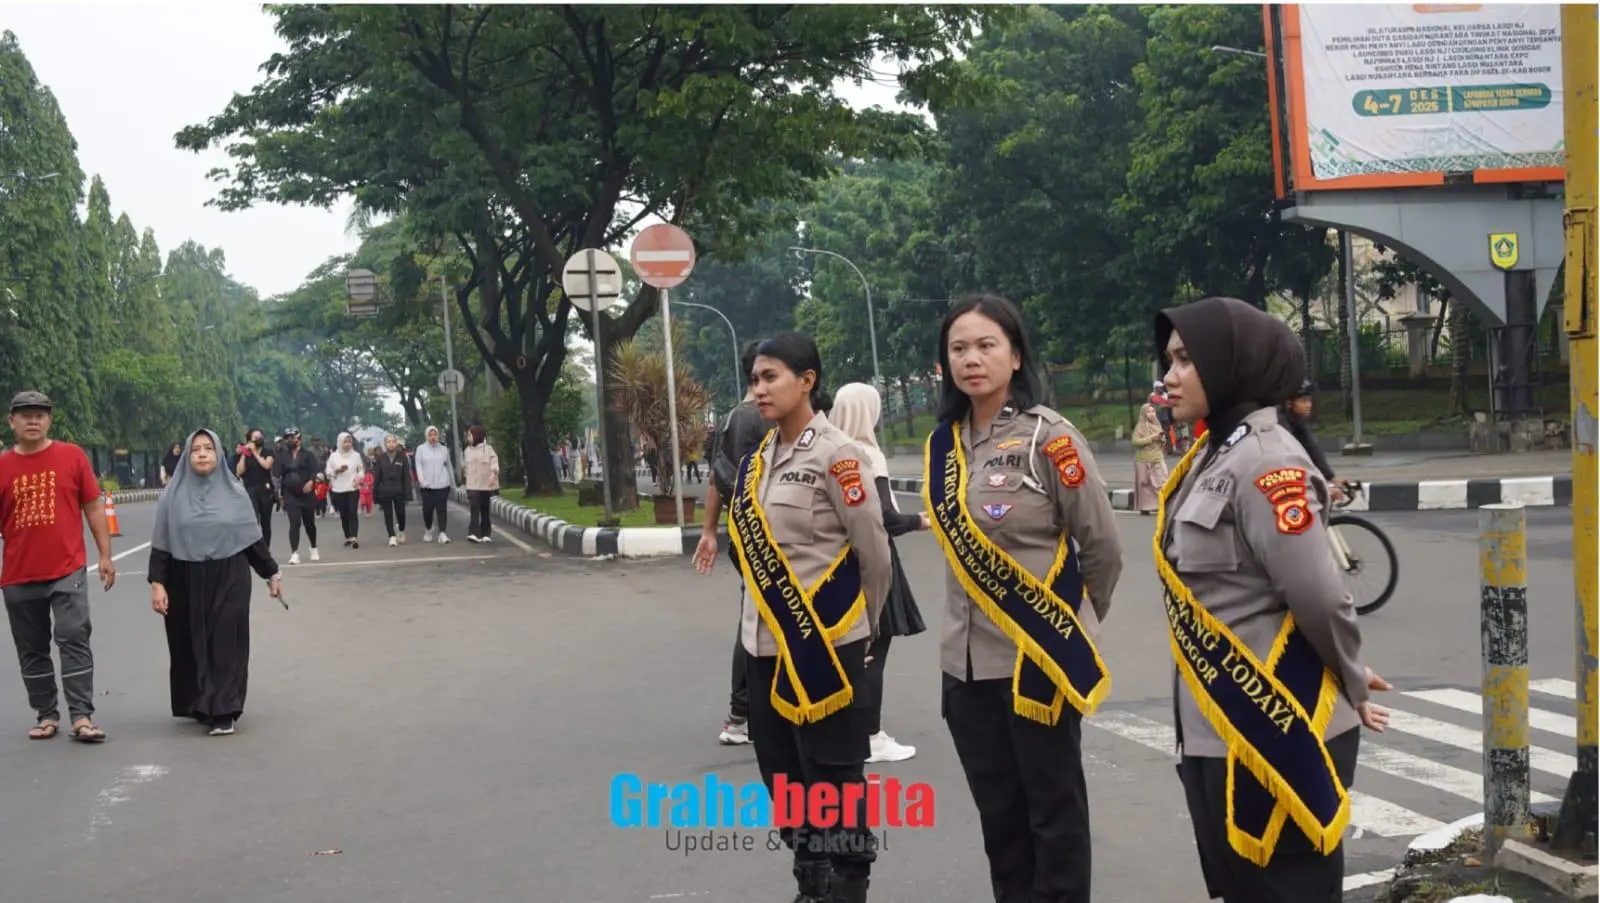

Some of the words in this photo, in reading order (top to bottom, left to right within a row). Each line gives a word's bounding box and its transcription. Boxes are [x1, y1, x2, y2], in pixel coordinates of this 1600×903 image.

[779, 471, 817, 485] POLRI
[734, 495, 751, 544] POLRES
[745, 543, 772, 590] BOGOR
[744, 505, 780, 573] MOJANG
[776, 576, 812, 639] LODAYA
[936, 502, 966, 556] POLRES
[965, 553, 1008, 600] BOGOR
[1014, 581, 1074, 640] LODAYA
[1176, 626, 1218, 687] BOGOR
[1221, 650, 1295, 735] LODAYA
